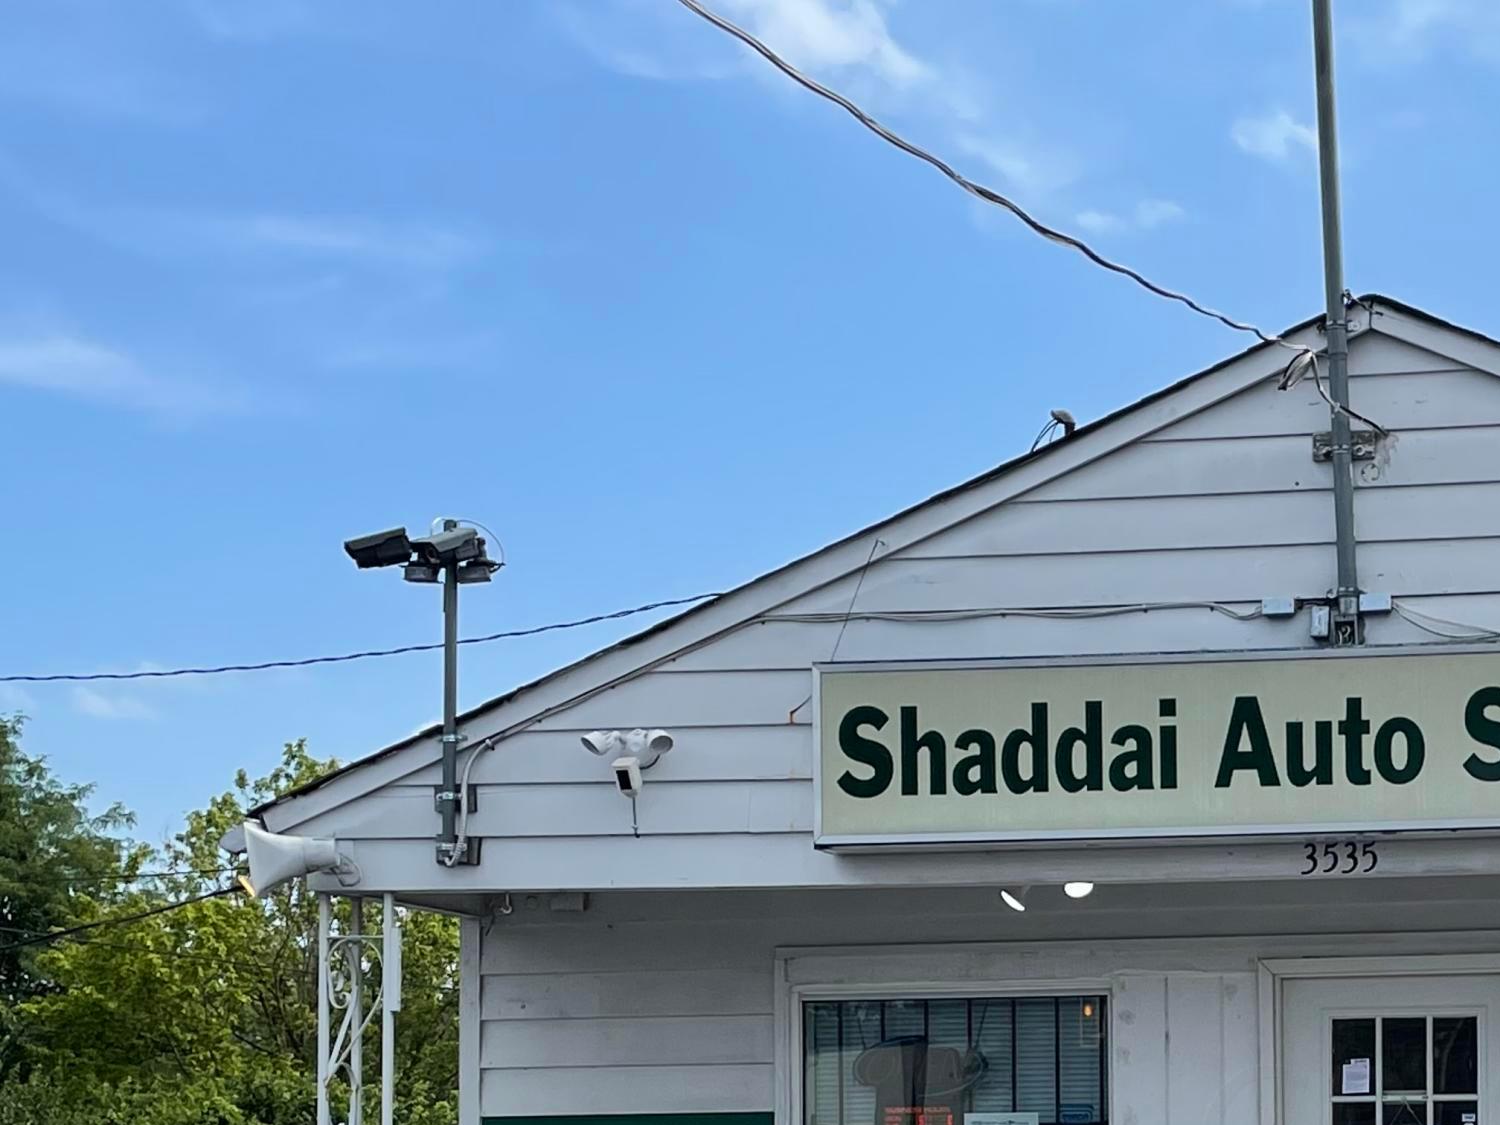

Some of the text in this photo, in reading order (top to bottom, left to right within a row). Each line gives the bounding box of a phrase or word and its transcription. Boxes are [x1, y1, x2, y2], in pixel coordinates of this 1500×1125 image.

[836, 698, 1178, 799] Shaddai
[1214, 695, 1426, 789] Auto
[1301, 839, 1379, 876] 3535
